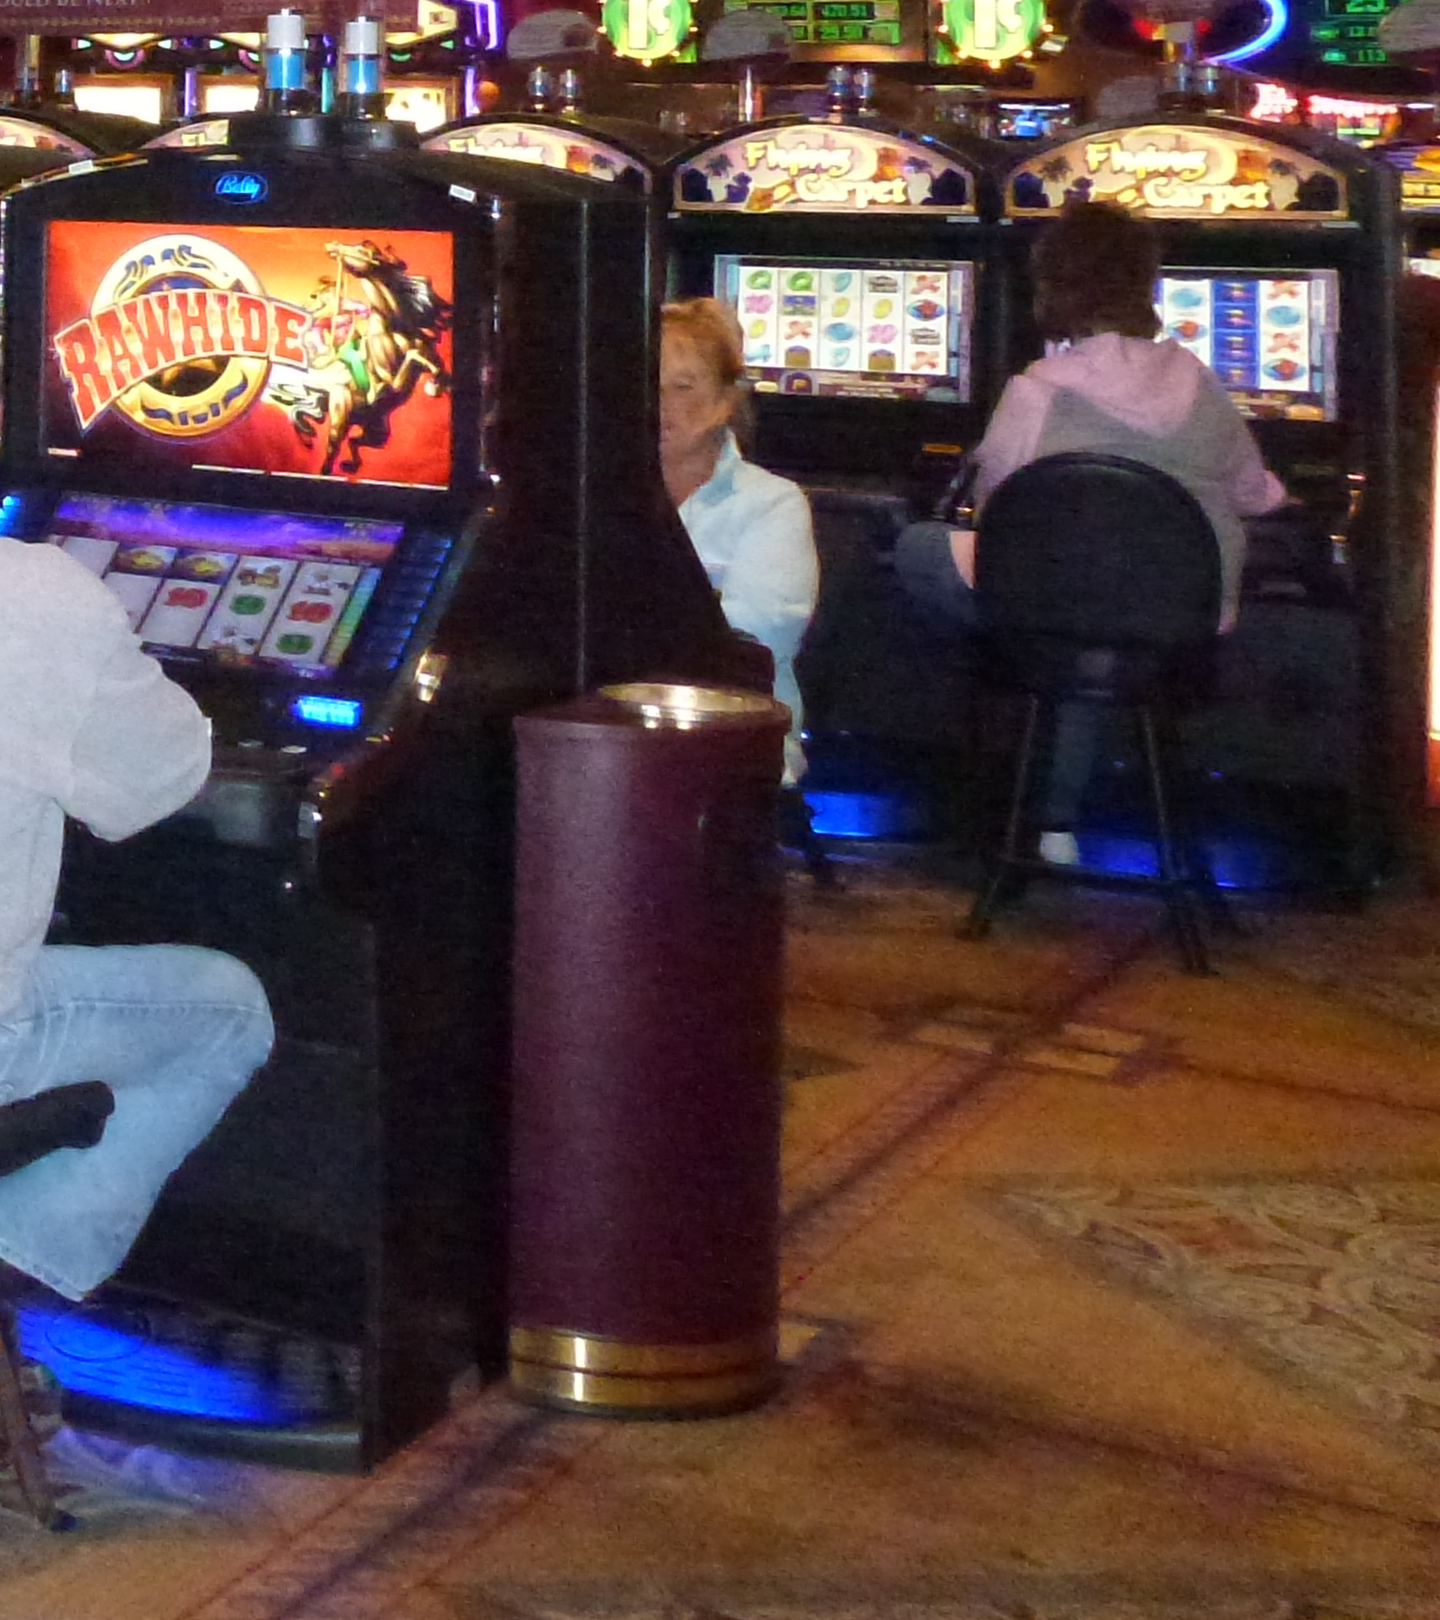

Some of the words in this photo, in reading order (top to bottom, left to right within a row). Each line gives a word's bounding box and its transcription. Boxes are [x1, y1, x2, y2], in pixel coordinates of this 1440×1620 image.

[746, 140, 853, 177] Flying
[1085, 141, 1208, 180] Flying
[216, 175, 260, 199] Bally
[795, 174, 908, 208] Carpet
[1143, 177, 1270, 213] Carpet
[54, 289, 312, 430] RAWHIDE
